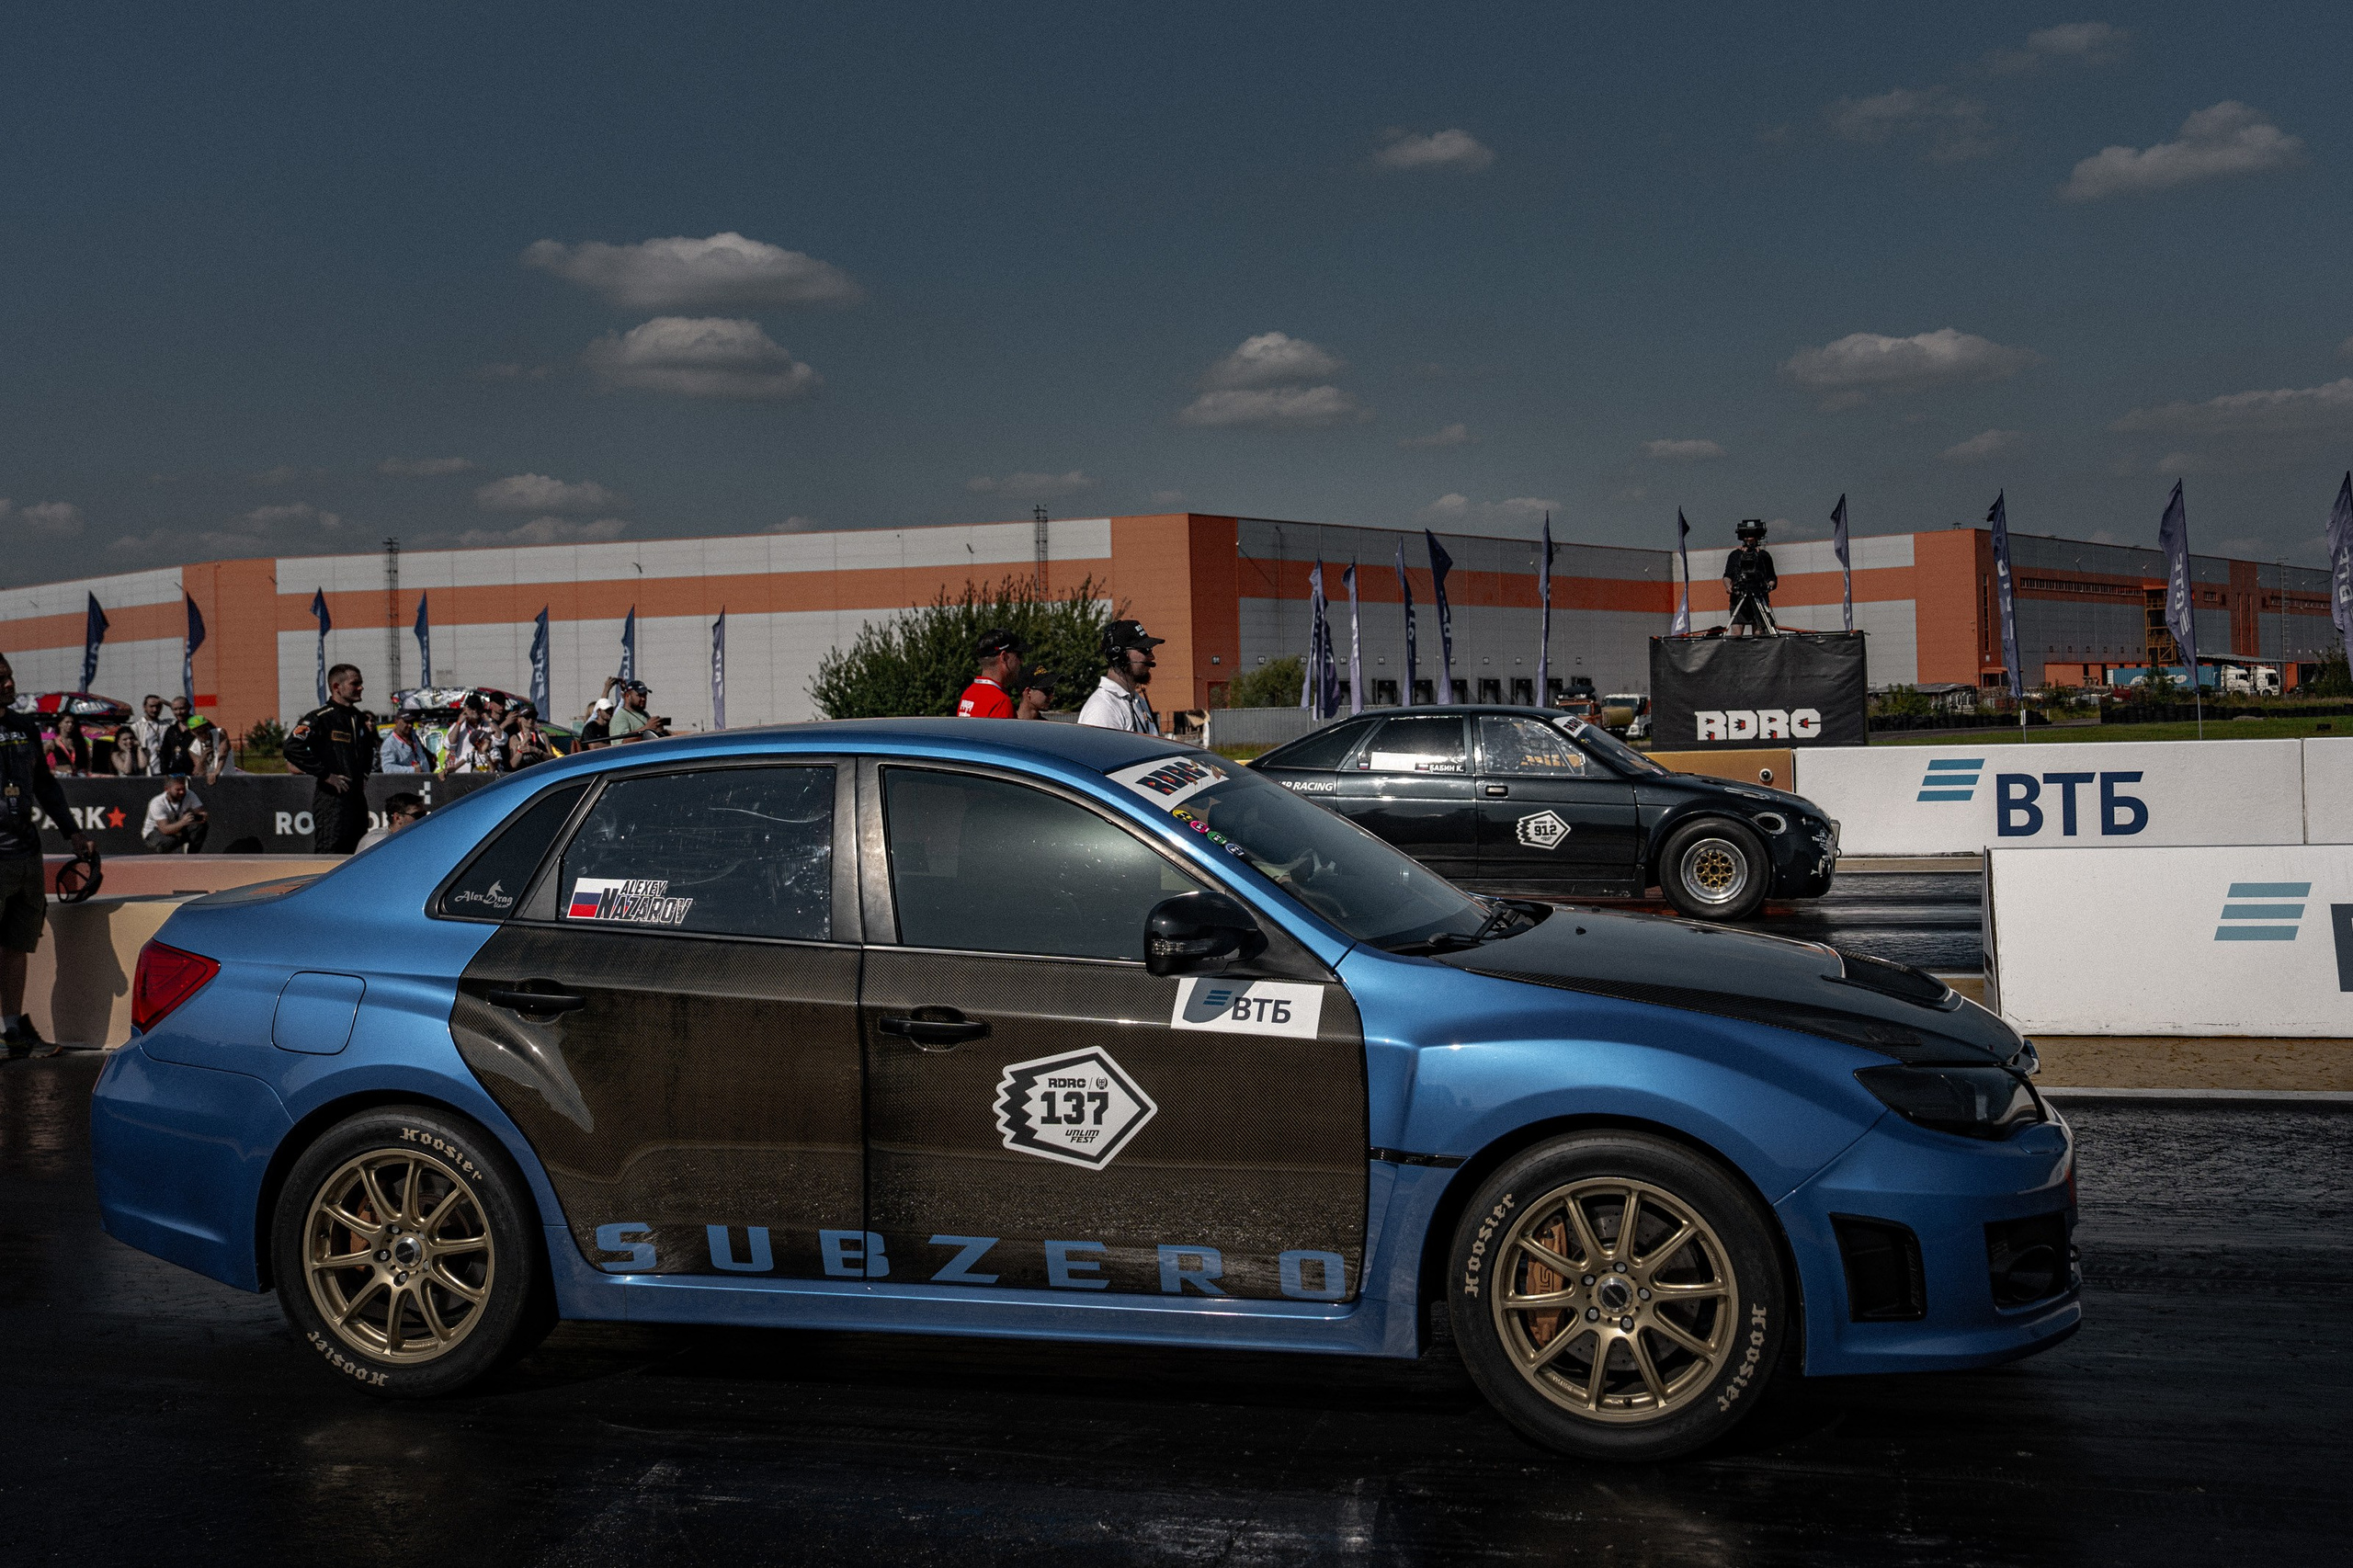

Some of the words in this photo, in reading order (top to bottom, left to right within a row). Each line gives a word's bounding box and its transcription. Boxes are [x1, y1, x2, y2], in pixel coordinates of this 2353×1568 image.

[1694, 708, 1822, 741] RDRC
[1292, 781, 1334, 791] RACING
[1996, 771, 2149, 836] ВТБ
[1534, 824, 1557, 835] 912
[595, 887, 693, 924] NAZAROV
[620, 880, 668, 897] ALEXEY
[1232, 997, 1292, 1024] ВТБ
[1048, 1078, 1086, 1088] RDRC
[1040, 1091, 1109, 1126] 137
[399, 1127, 483, 1181] Hoosier
[596, 1221, 1347, 1300] SUBZERO
[1464, 1192, 1516, 1299] Hoosier
[306, 1330, 390, 1388] Hoosier
[1716, 1302, 1768, 1413] Hoosier
